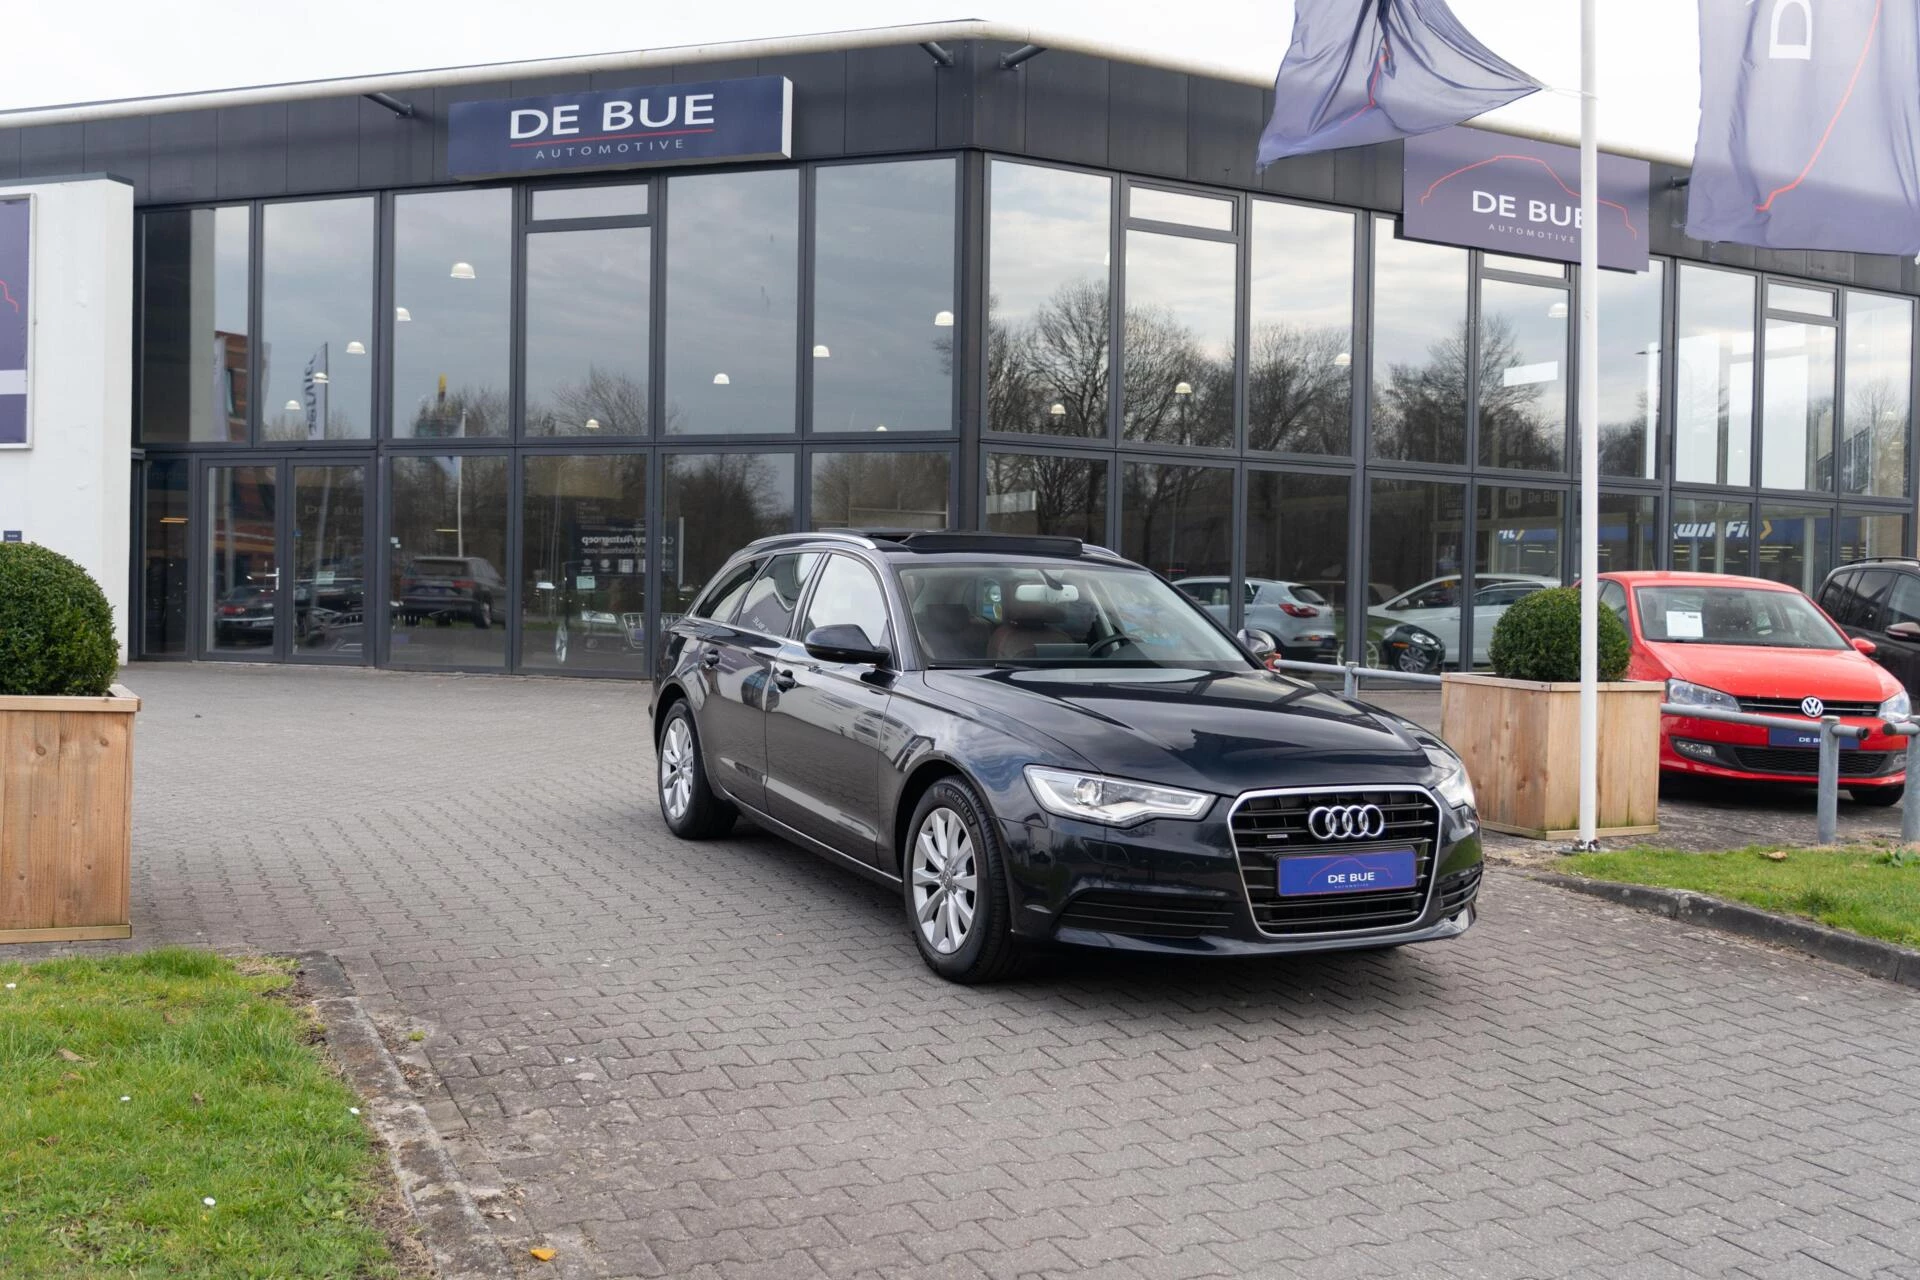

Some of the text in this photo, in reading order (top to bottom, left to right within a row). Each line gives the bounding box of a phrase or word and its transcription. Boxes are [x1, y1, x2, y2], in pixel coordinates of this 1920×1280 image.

[510, 93, 714, 139] DE BUE
[535, 138, 684, 160] AUTOMOTIVE
[1472, 190, 1516, 218] DE
[1488, 223, 1576, 244] AUTOMOTIVE
[1327, 871, 1375, 884] DE BUE
